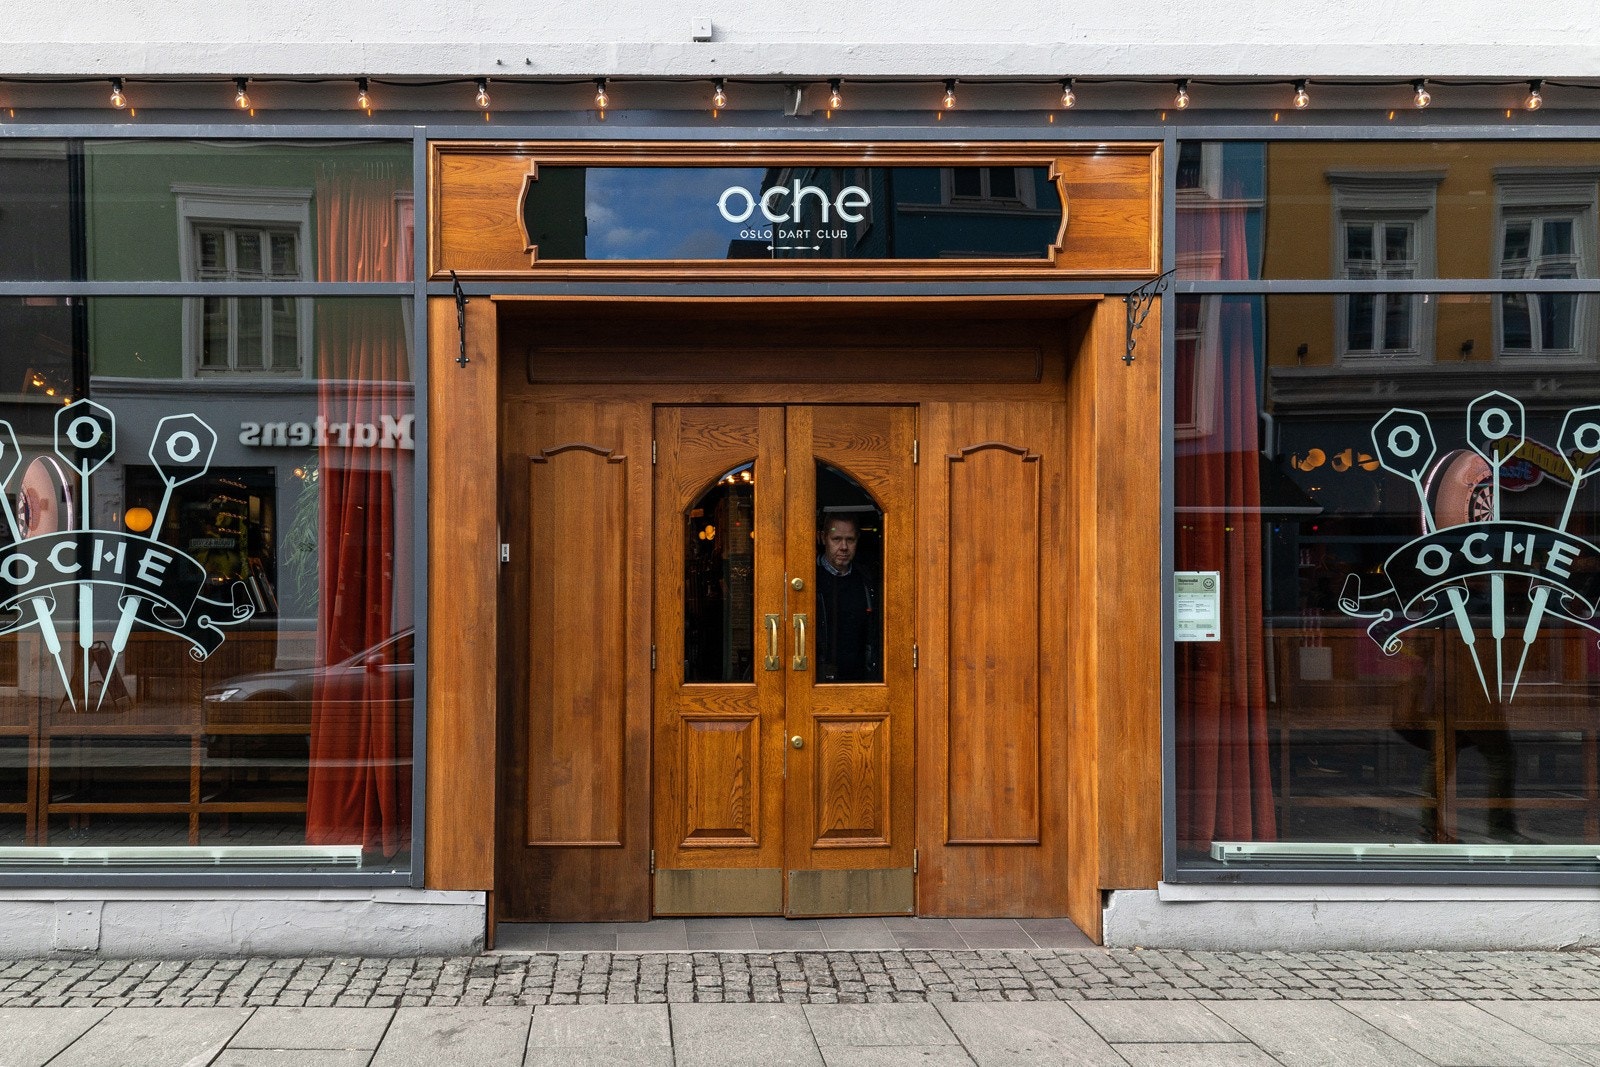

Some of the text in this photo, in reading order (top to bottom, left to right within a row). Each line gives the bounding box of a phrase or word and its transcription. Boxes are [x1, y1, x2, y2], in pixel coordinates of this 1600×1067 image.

[716, 179, 871, 223] oche
[740, 229, 848, 239] OSLO DART CLUB
[0, 539, 173, 587] OCHE
[1415, 531, 1581, 579] OCHE
